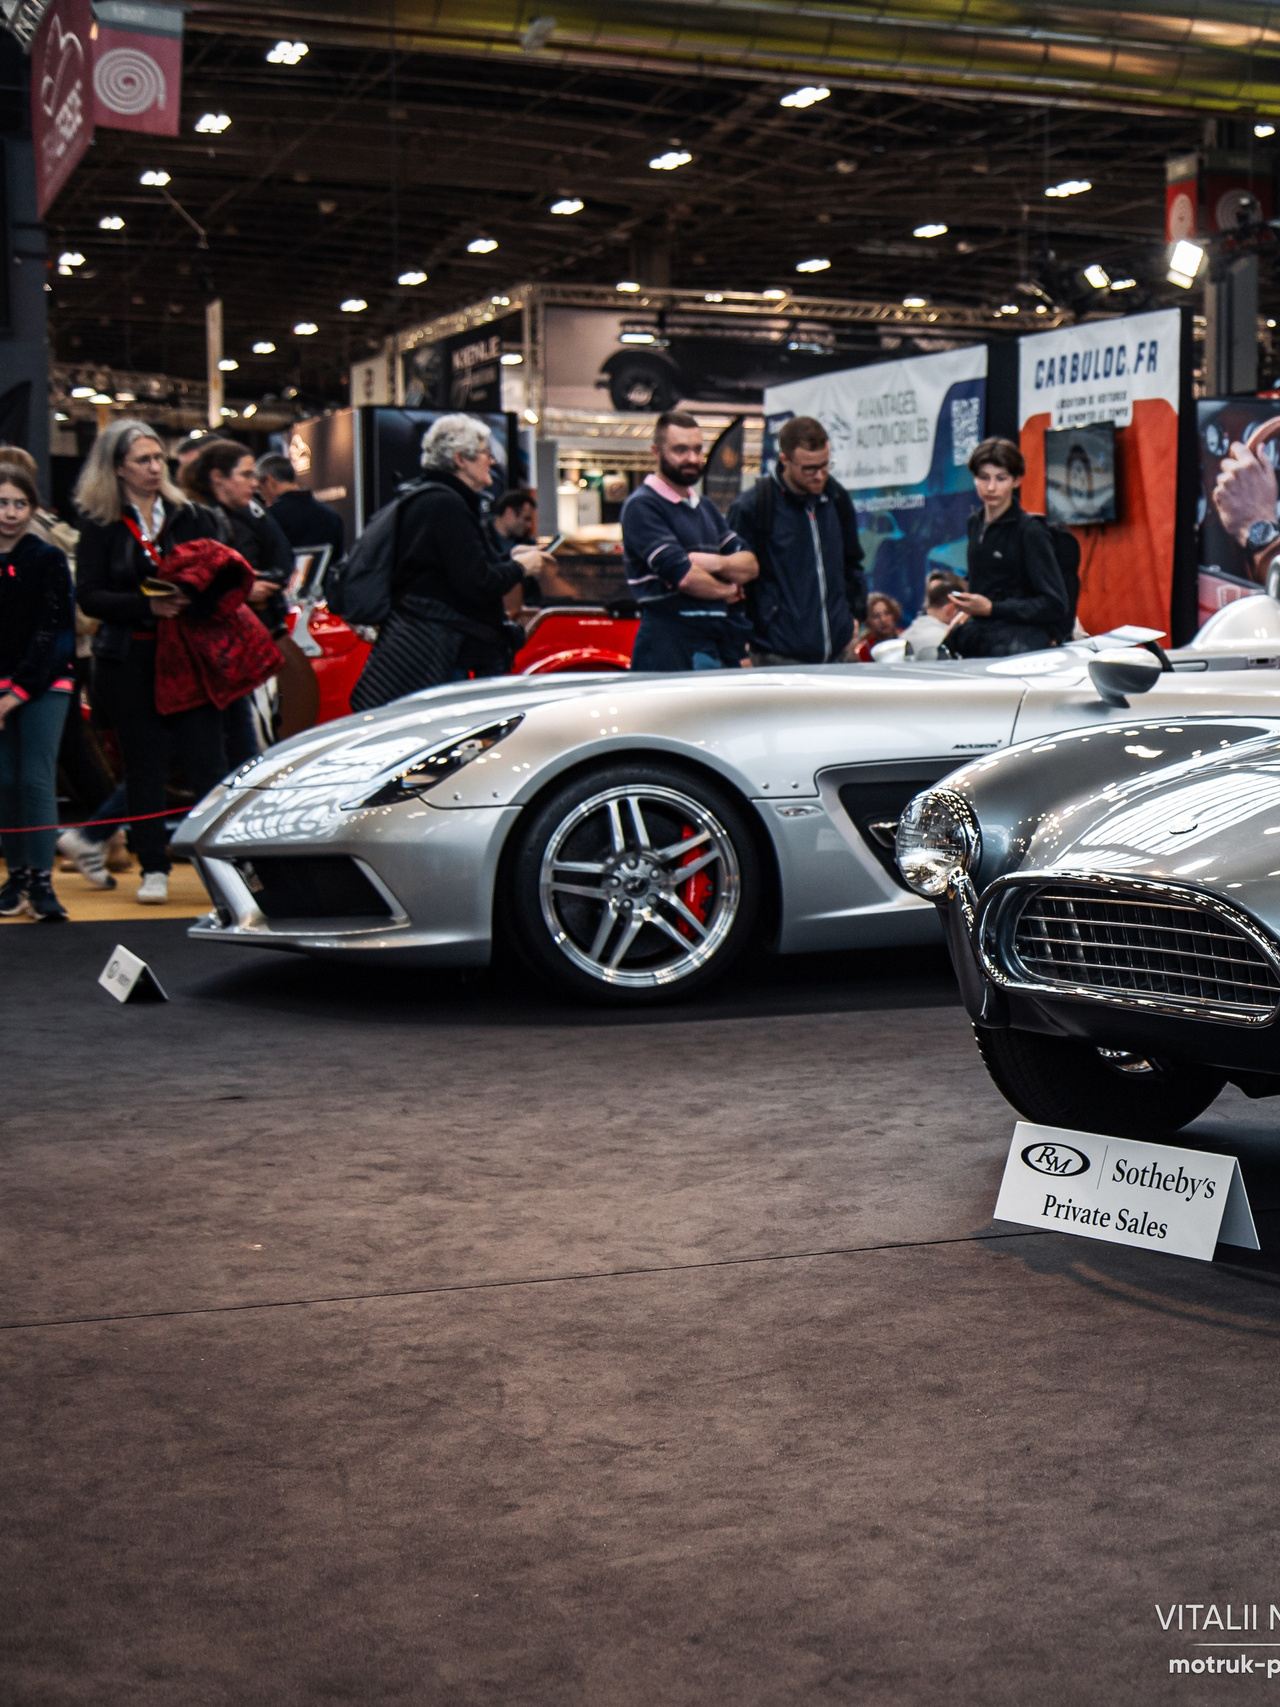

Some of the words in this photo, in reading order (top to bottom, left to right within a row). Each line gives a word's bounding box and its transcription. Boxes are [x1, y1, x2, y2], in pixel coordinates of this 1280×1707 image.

[1034, 340, 1159, 390] CARBULOC.FR
[856, 389, 917, 419] AVANTAGES
[856, 418, 930, 448] AUTOMOBILES
[1111, 1158, 1217, 1202] Sotheby's
[1041, 1193, 1112, 1229] Private
[1115, 1207, 1169, 1240] Sales
